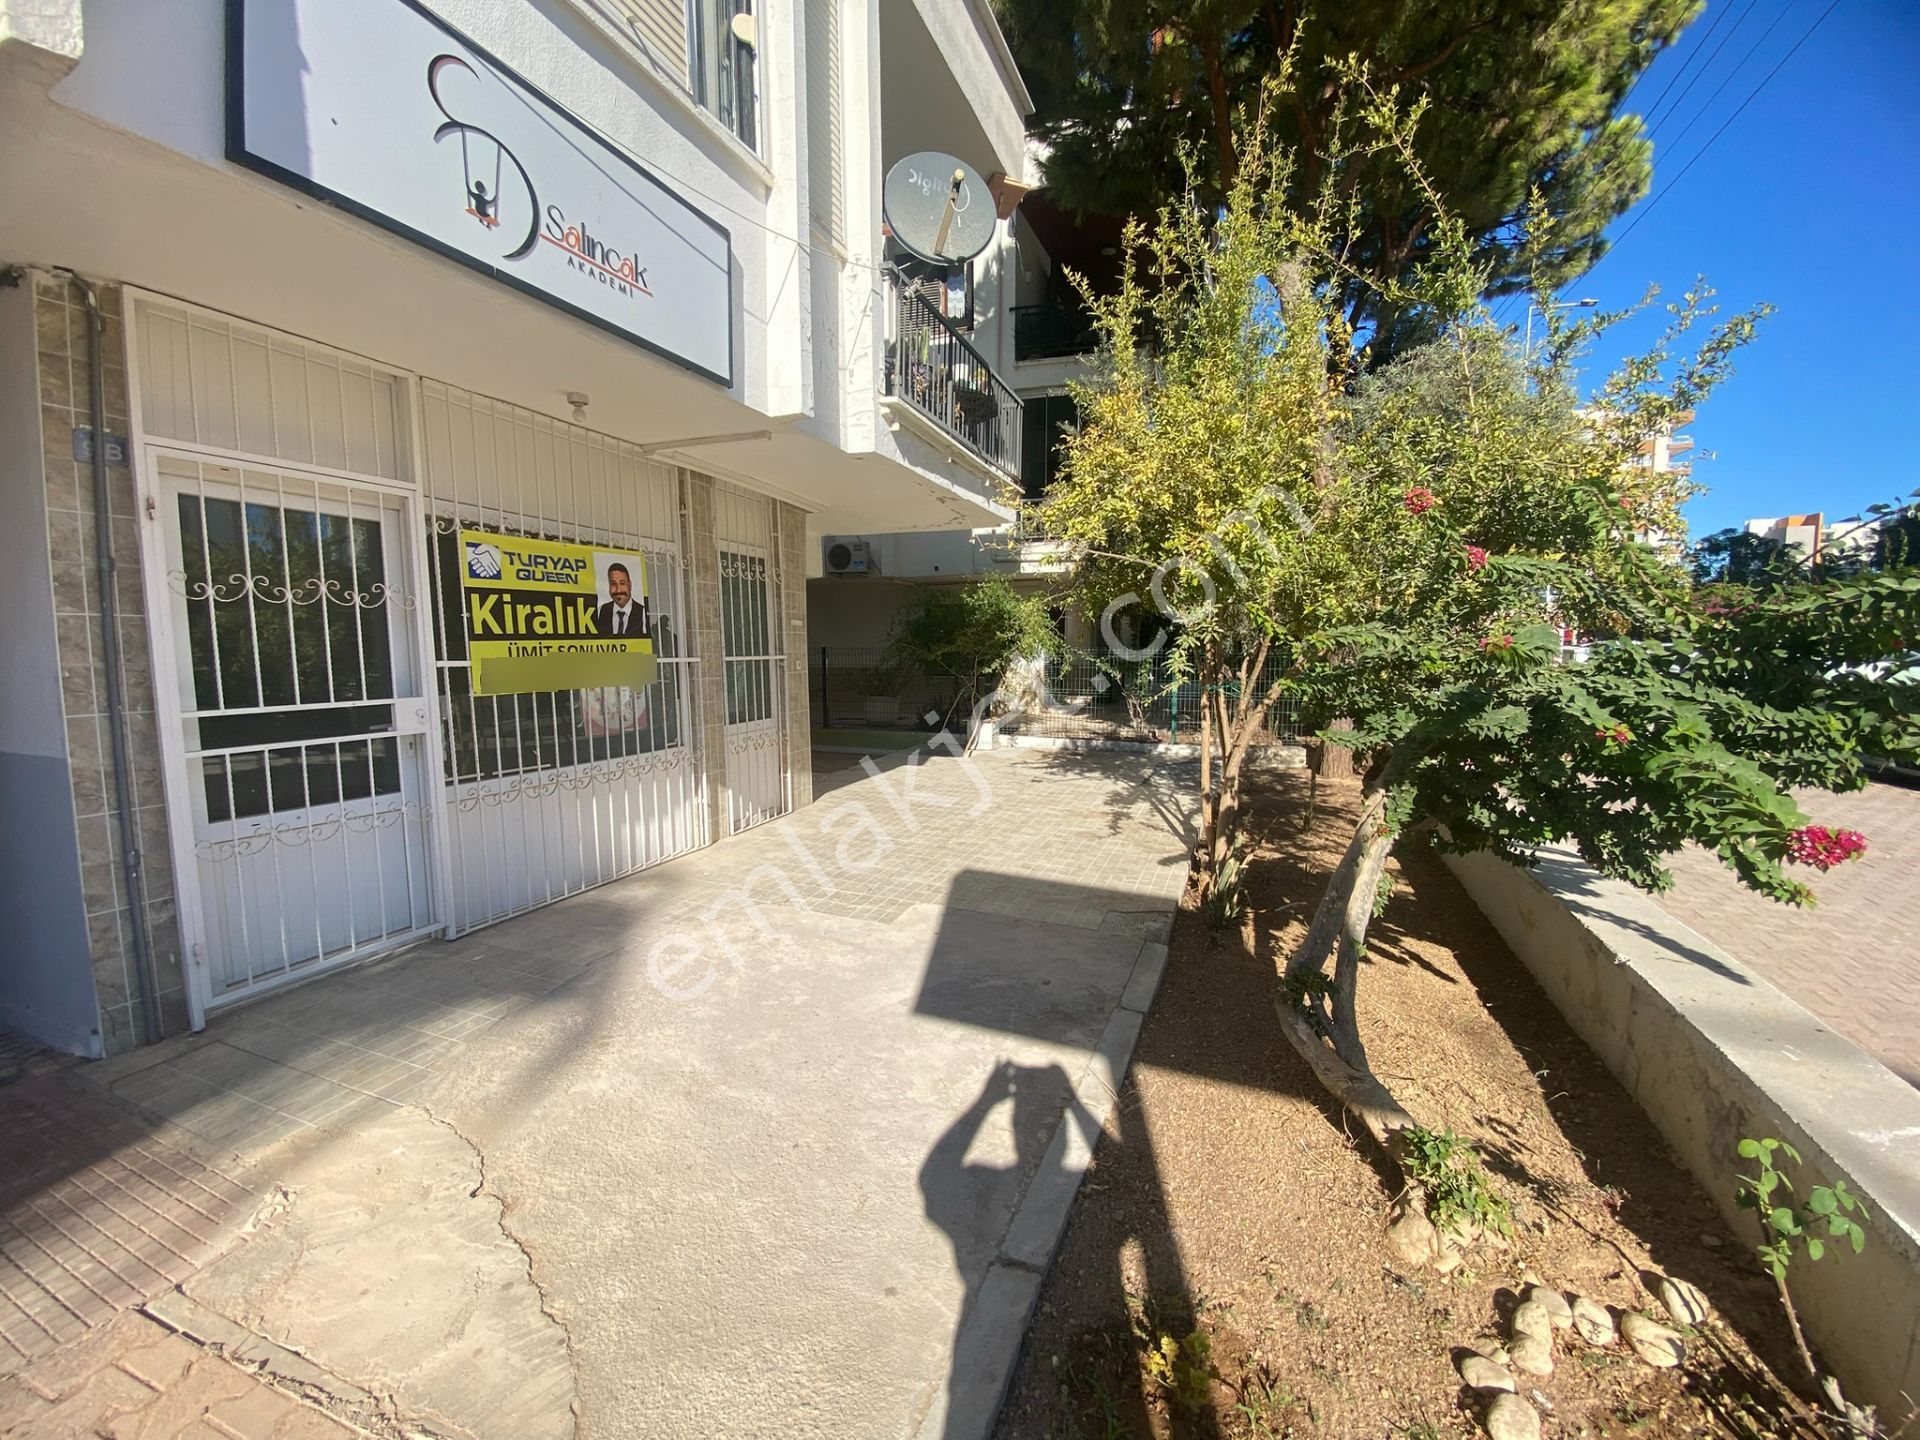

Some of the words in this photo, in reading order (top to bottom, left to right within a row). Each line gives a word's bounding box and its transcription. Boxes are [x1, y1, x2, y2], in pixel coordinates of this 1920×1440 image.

[545, 204, 649, 289] Salıncak
[503, 551, 587, 572] TURYAP
[516, 568, 578, 585] QUEEN
[470, 593, 599, 635] Kiralık
